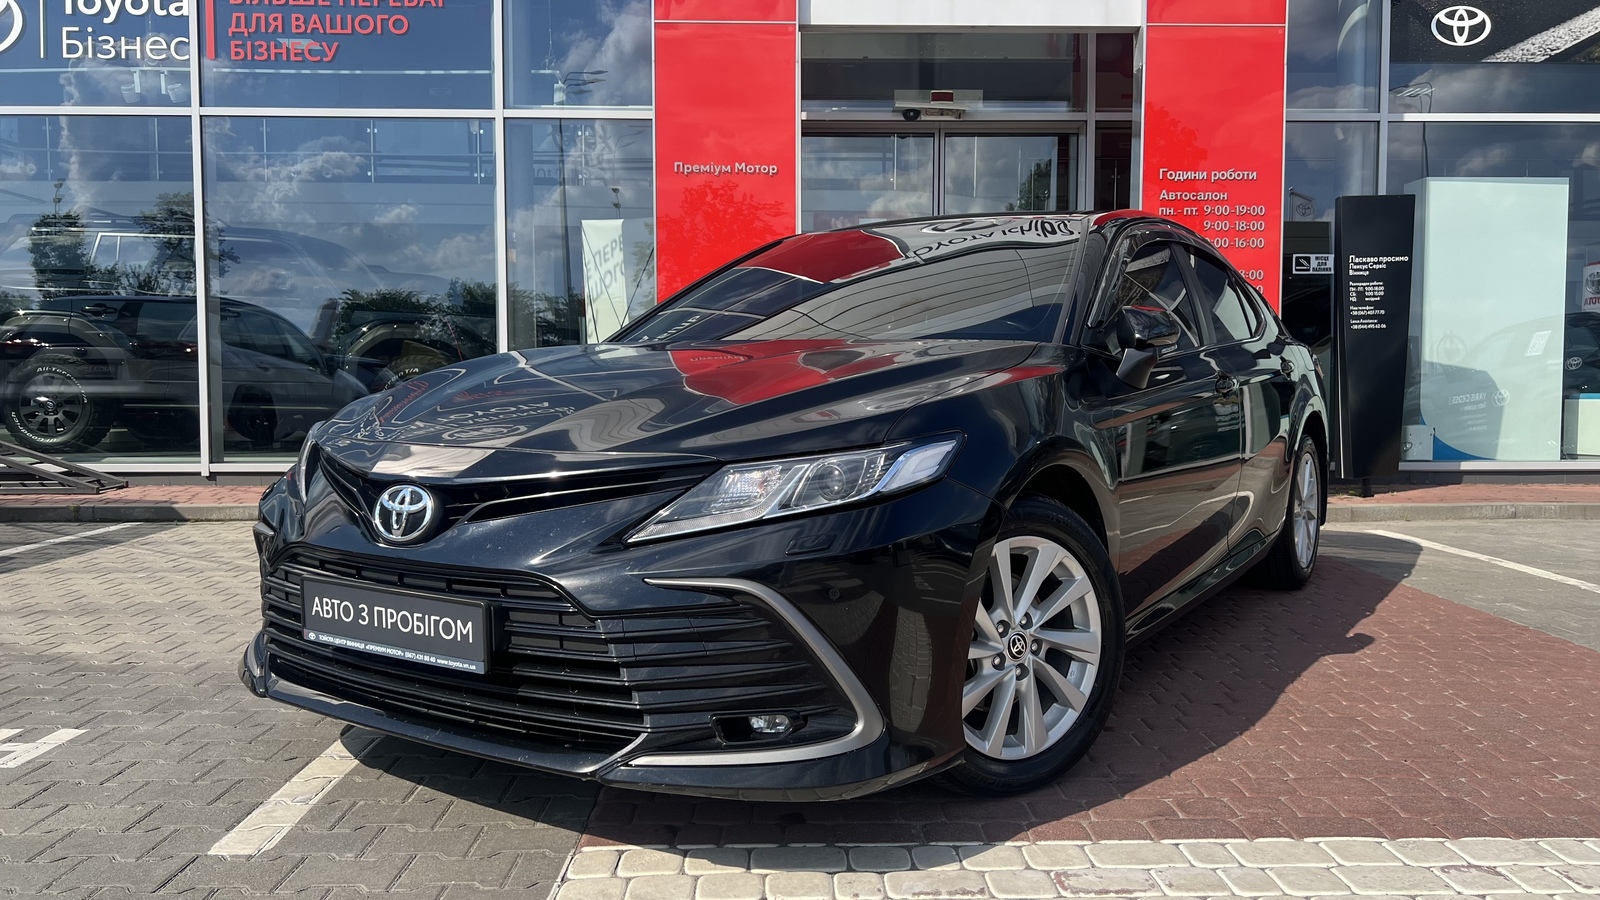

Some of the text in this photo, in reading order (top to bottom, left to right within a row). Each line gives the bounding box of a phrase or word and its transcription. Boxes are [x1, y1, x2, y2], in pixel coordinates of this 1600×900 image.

[228, 12, 409, 36] ДЛЯ ВАШОГО
[62, 26, 190, 60] Бізнес
[230, 40, 339, 62] БІЗНЕСУ
[674, 161, 778, 175] Преміум Мотор
[1159, 168, 1258, 183] Години роботи
[1159, 189, 1228, 201] Автосалон
[1203, 204, 1266, 216] 9:00-19:00
[1203, 220, 1265, 231] 9:00-18:00
[1349, 255, 1378, 263] Ласкаво
[312, 596, 354, 622] АВТО
[373, 606, 473, 643] ПРОБІГОМ
